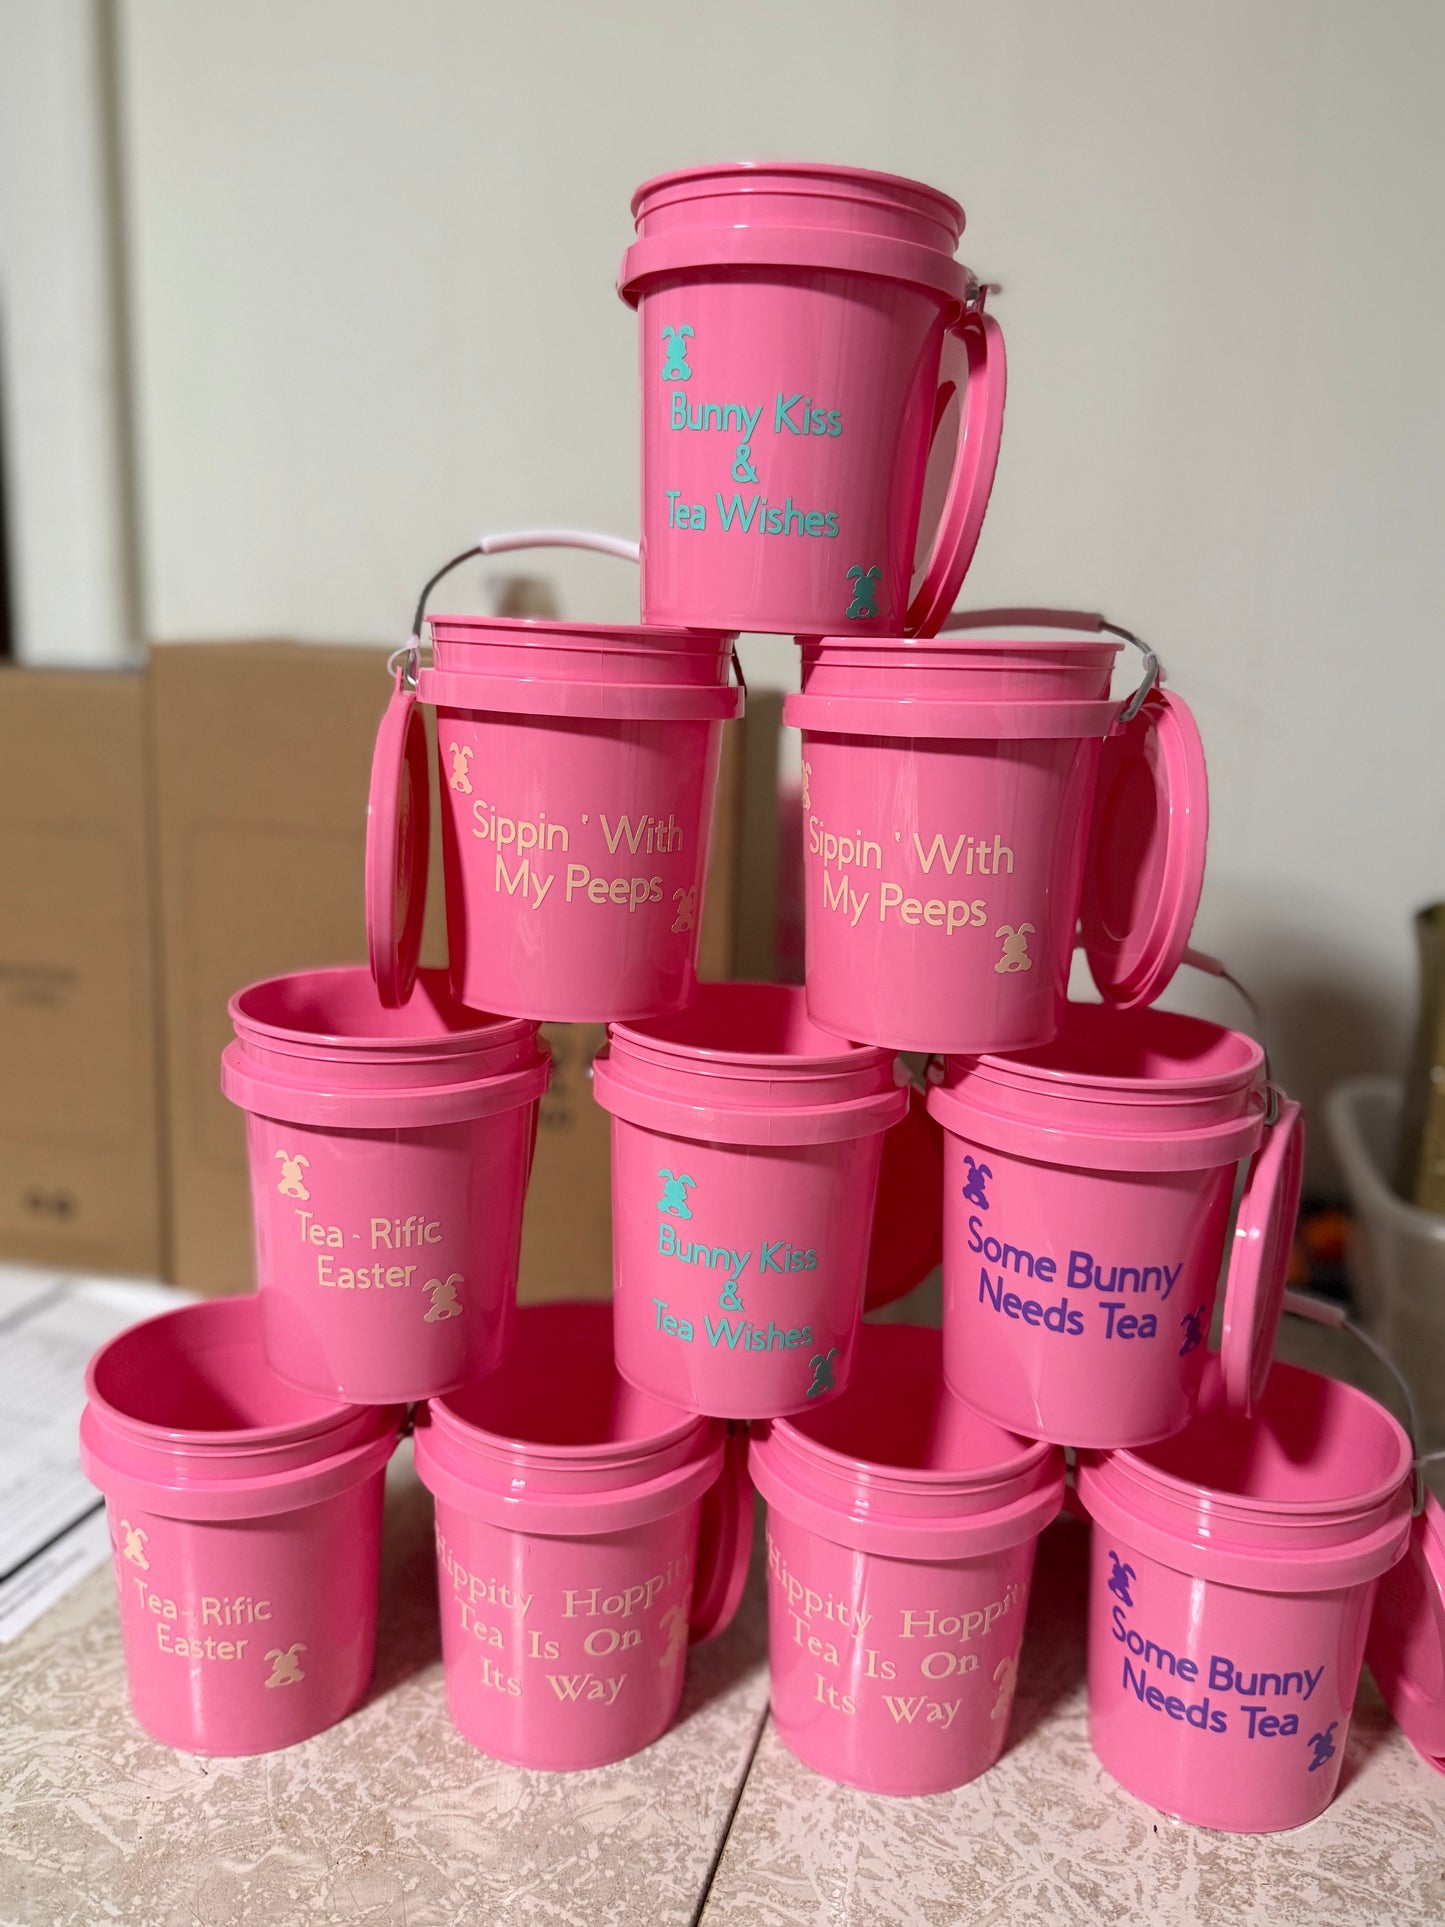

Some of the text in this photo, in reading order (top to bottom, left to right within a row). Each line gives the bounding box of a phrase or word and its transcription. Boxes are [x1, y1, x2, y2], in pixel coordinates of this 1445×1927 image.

[671, 391, 843, 444] Bunny Kiss
[731, 444, 760, 484] &
[665, 490, 840, 538] Tea Wishes
[599, 814, 684, 855] With
[912, 832, 1015, 875] With
[495, 854, 664, 913] My Peeps
[822, 870, 989, 936] My Peeps
[317, 1254, 418, 1289] Easter
[658, 1222, 818, 1280] Bunny Kiss
[967, 1215, 1183, 1301] Some Bunny
[651, 1297, 814, 1351] Tea Wishes
[718, 1280, 744, 1312] &
[978, 1266, 1158, 1339] Needs Tea
[767, 1533, 874, 1639] Hippity
[156, 1621, 249, 1661] Easter
[454, 1594, 643, 1659] Tea Is On
[787, 1607, 980, 1681] Tea Is On
[1111, 1605, 1325, 1701] Some Bunny
[480, 1656, 628, 1705] Its Way
[814, 1673, 963, 1730] Its Way
[1122, 1656, 1299, 1740] Needs Tea
